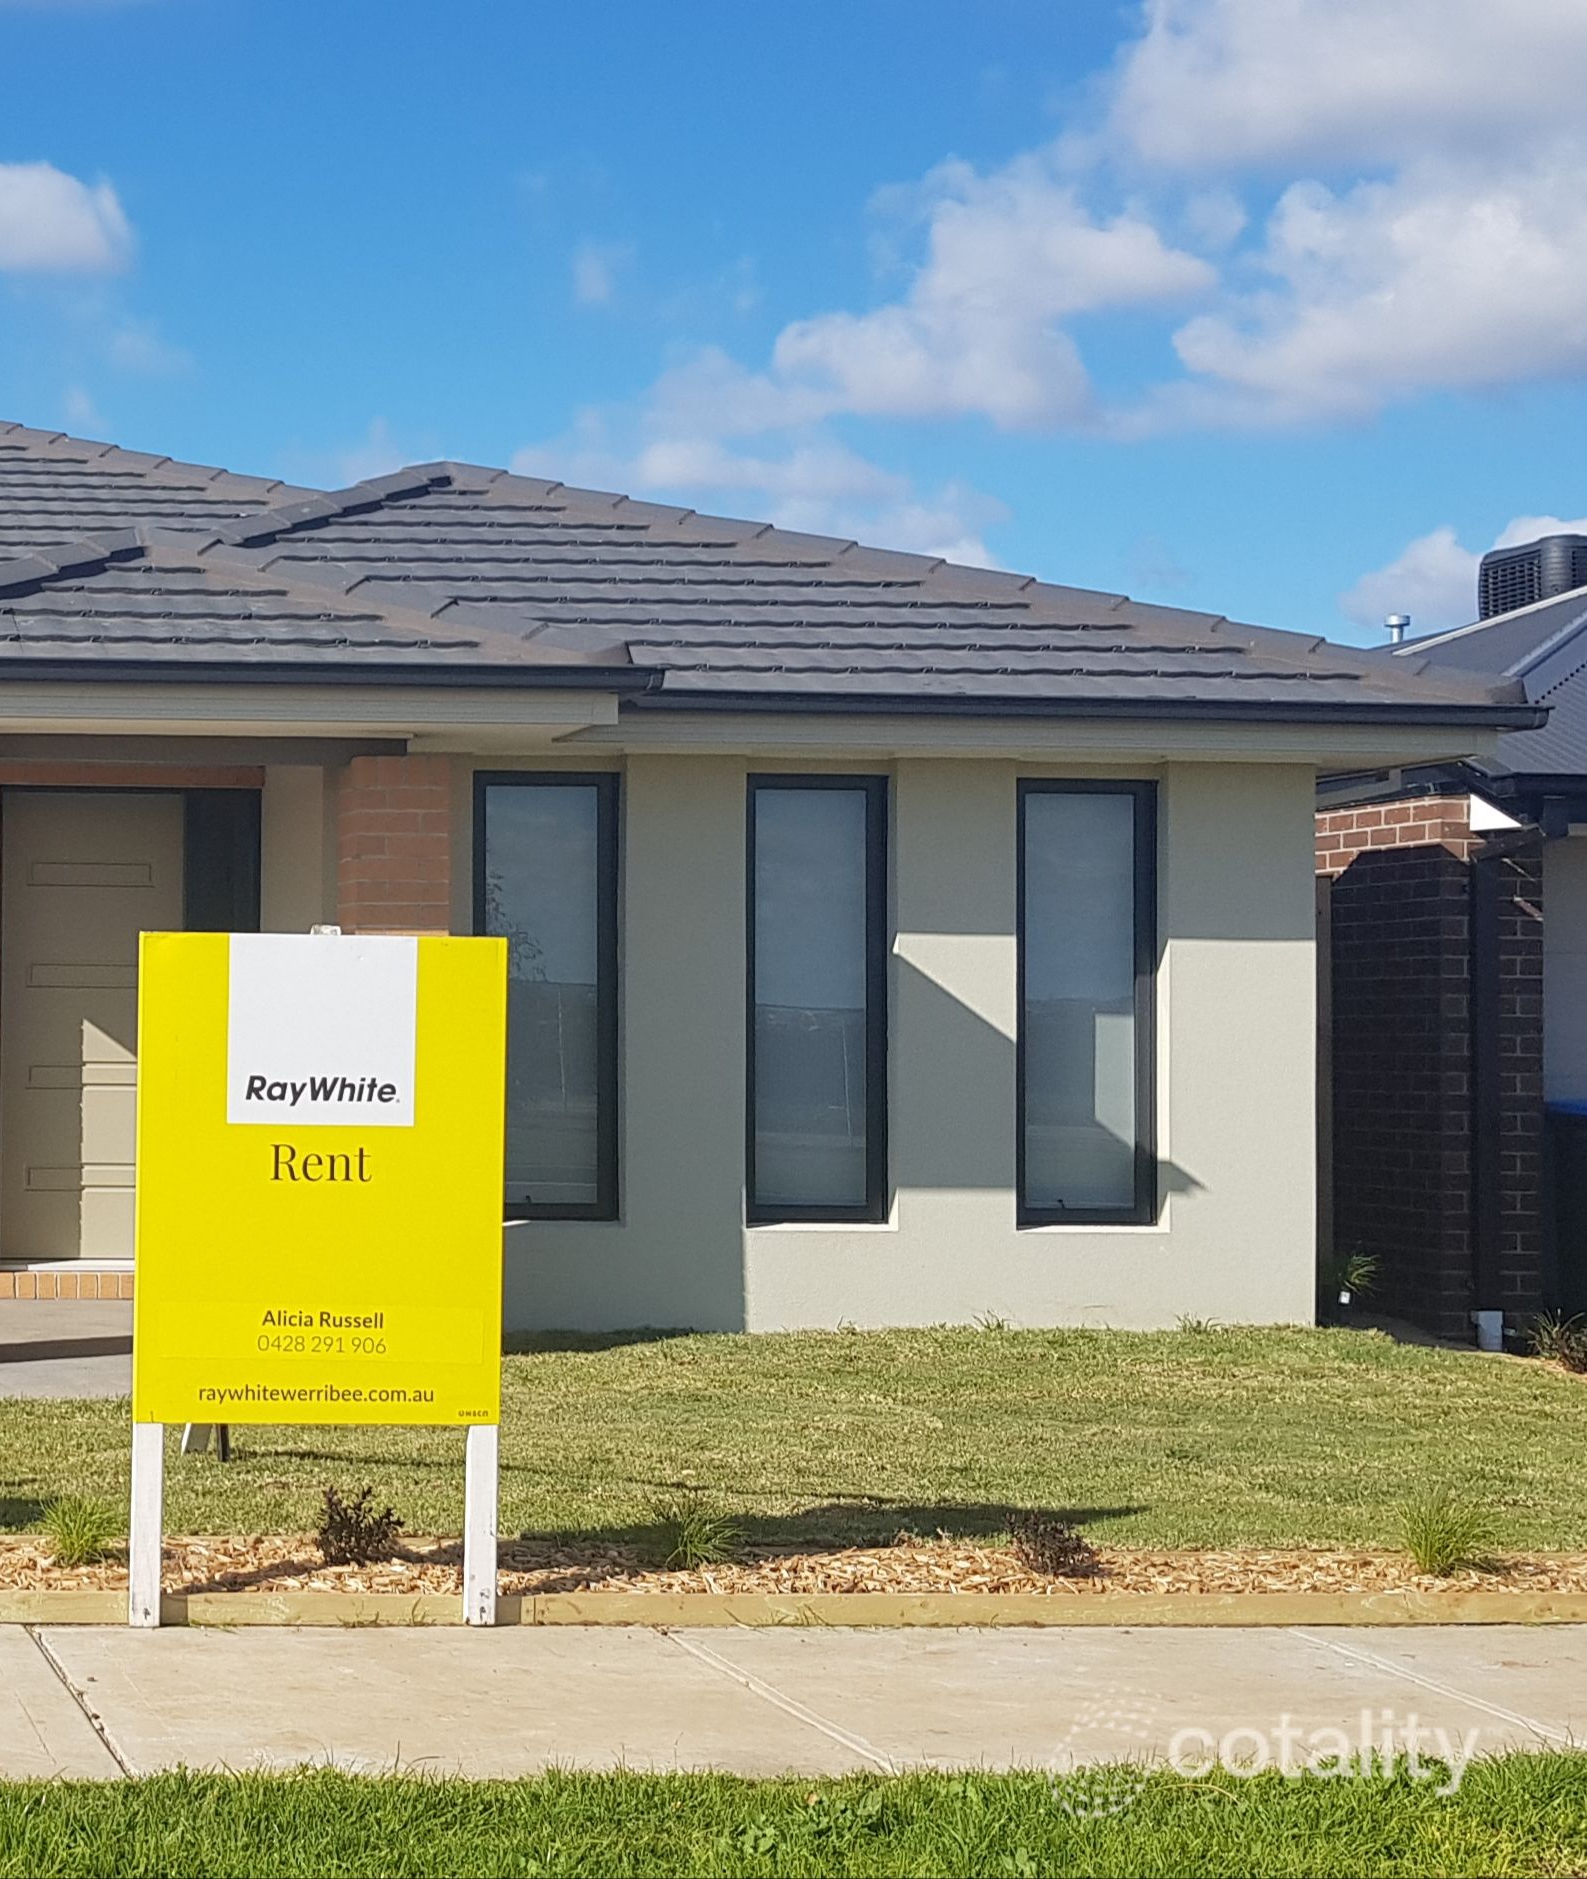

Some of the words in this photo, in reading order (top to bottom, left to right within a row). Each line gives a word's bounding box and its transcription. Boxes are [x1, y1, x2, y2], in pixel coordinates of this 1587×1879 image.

[270, 1143, 372, 1182] Rent
[262, 1310, 314, 1327] Alicia
[319, 1312, 384, 1329] Russell
[257, 1335, 306, 1352] 0428
[311, 1336, 345, 1353] 291
[351, 1337, 387, 1354] 906
[199, 1384, 434, 1404] raywhitewerribee.com.au
